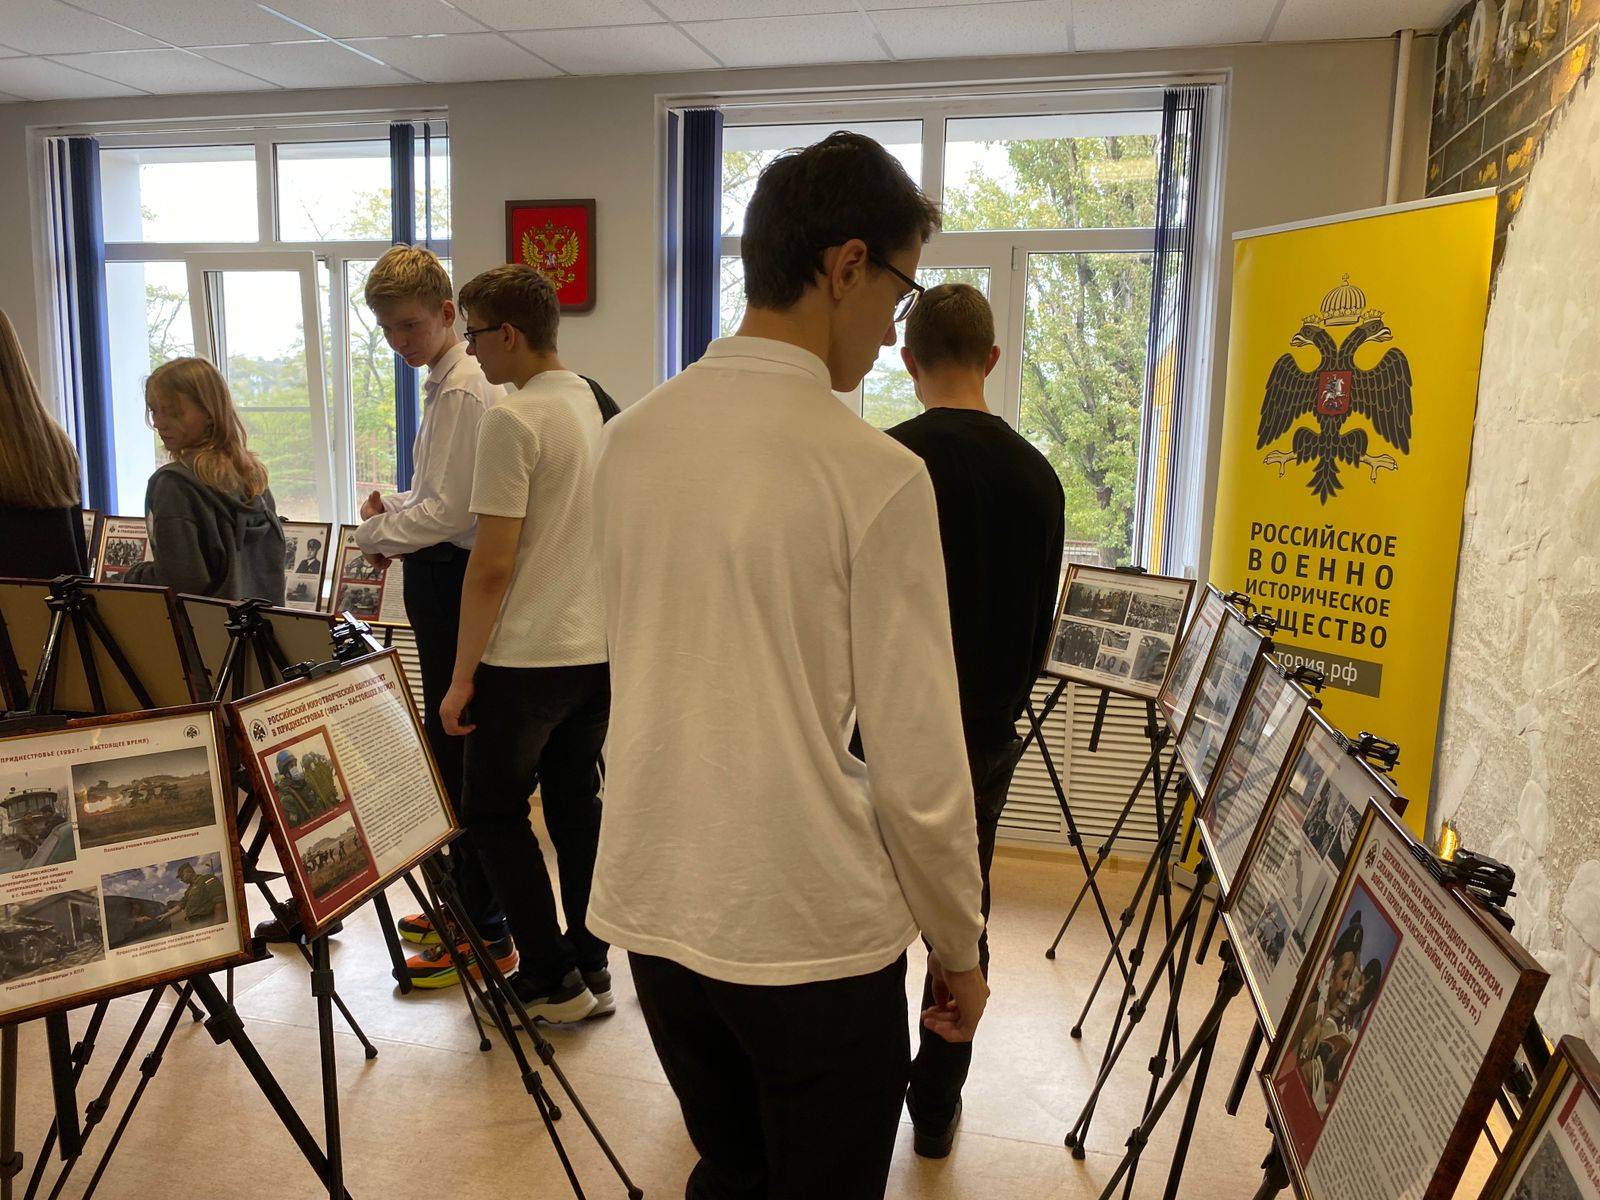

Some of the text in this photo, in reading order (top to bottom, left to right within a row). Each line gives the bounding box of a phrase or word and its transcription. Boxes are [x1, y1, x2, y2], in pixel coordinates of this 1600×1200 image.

[1250, 522, 1397, 558] РОССИЙСКОЕ
[1247, 548, 1394, 590] ВОЕННО
[1245, 578, 1391, 618] ИСТОРИЧЕСКОЕ
[1276, 651, 1358, 686] тория.рф
[267, 702, 307, 726] РОССИЙСКИЙ
[306, 685, 355, 710] МИРОТВОРЧЕСКИЙ
[271, 728, 277, 737] В
[276, 711, 325, 735] ПРИДНЕСТРОВЬЕ
[348, 688, 378, 706] НАСТОЯЩЕЕ
[0, 751, 54, 763] ПРИДНЕСТРОВЬЕ
[89, 741, 125, 751] НАСТОЯЩЕЕ
[127, 737, 150, 746] ВРЕМЯ)
[1371, 871, 1386, 893] ВОЙСК
[1385, 890, 1403, 919] ПЕРИОД
[1400, 910, 1427, 949] АФГАНСКОЙ
[1423, 942, 1444, 972] ВОЙНЫ
[1440, 966, 1471, 1010] (1979-1989
[1376, 860, 1394, 885] СИЛАМИ
[1391, 878, 1426, 925] ОГРАНИЧЕННОГО
[1423, 918, 1458, 969] КОНТИНГЕНТА
[1456, 961, 1491, 1009] СОВЕТСКИХ
[1382, 847, 1410, 885] СДЕРЖИВАНИЕ
[1407, 878, 1423, 901] ОЧАГА
[1421, 894, 1467, 954] МЕЖДУНАРОДНОГО
[1465, 947, 1504, 1000] ТЕРРОРИЗМА
